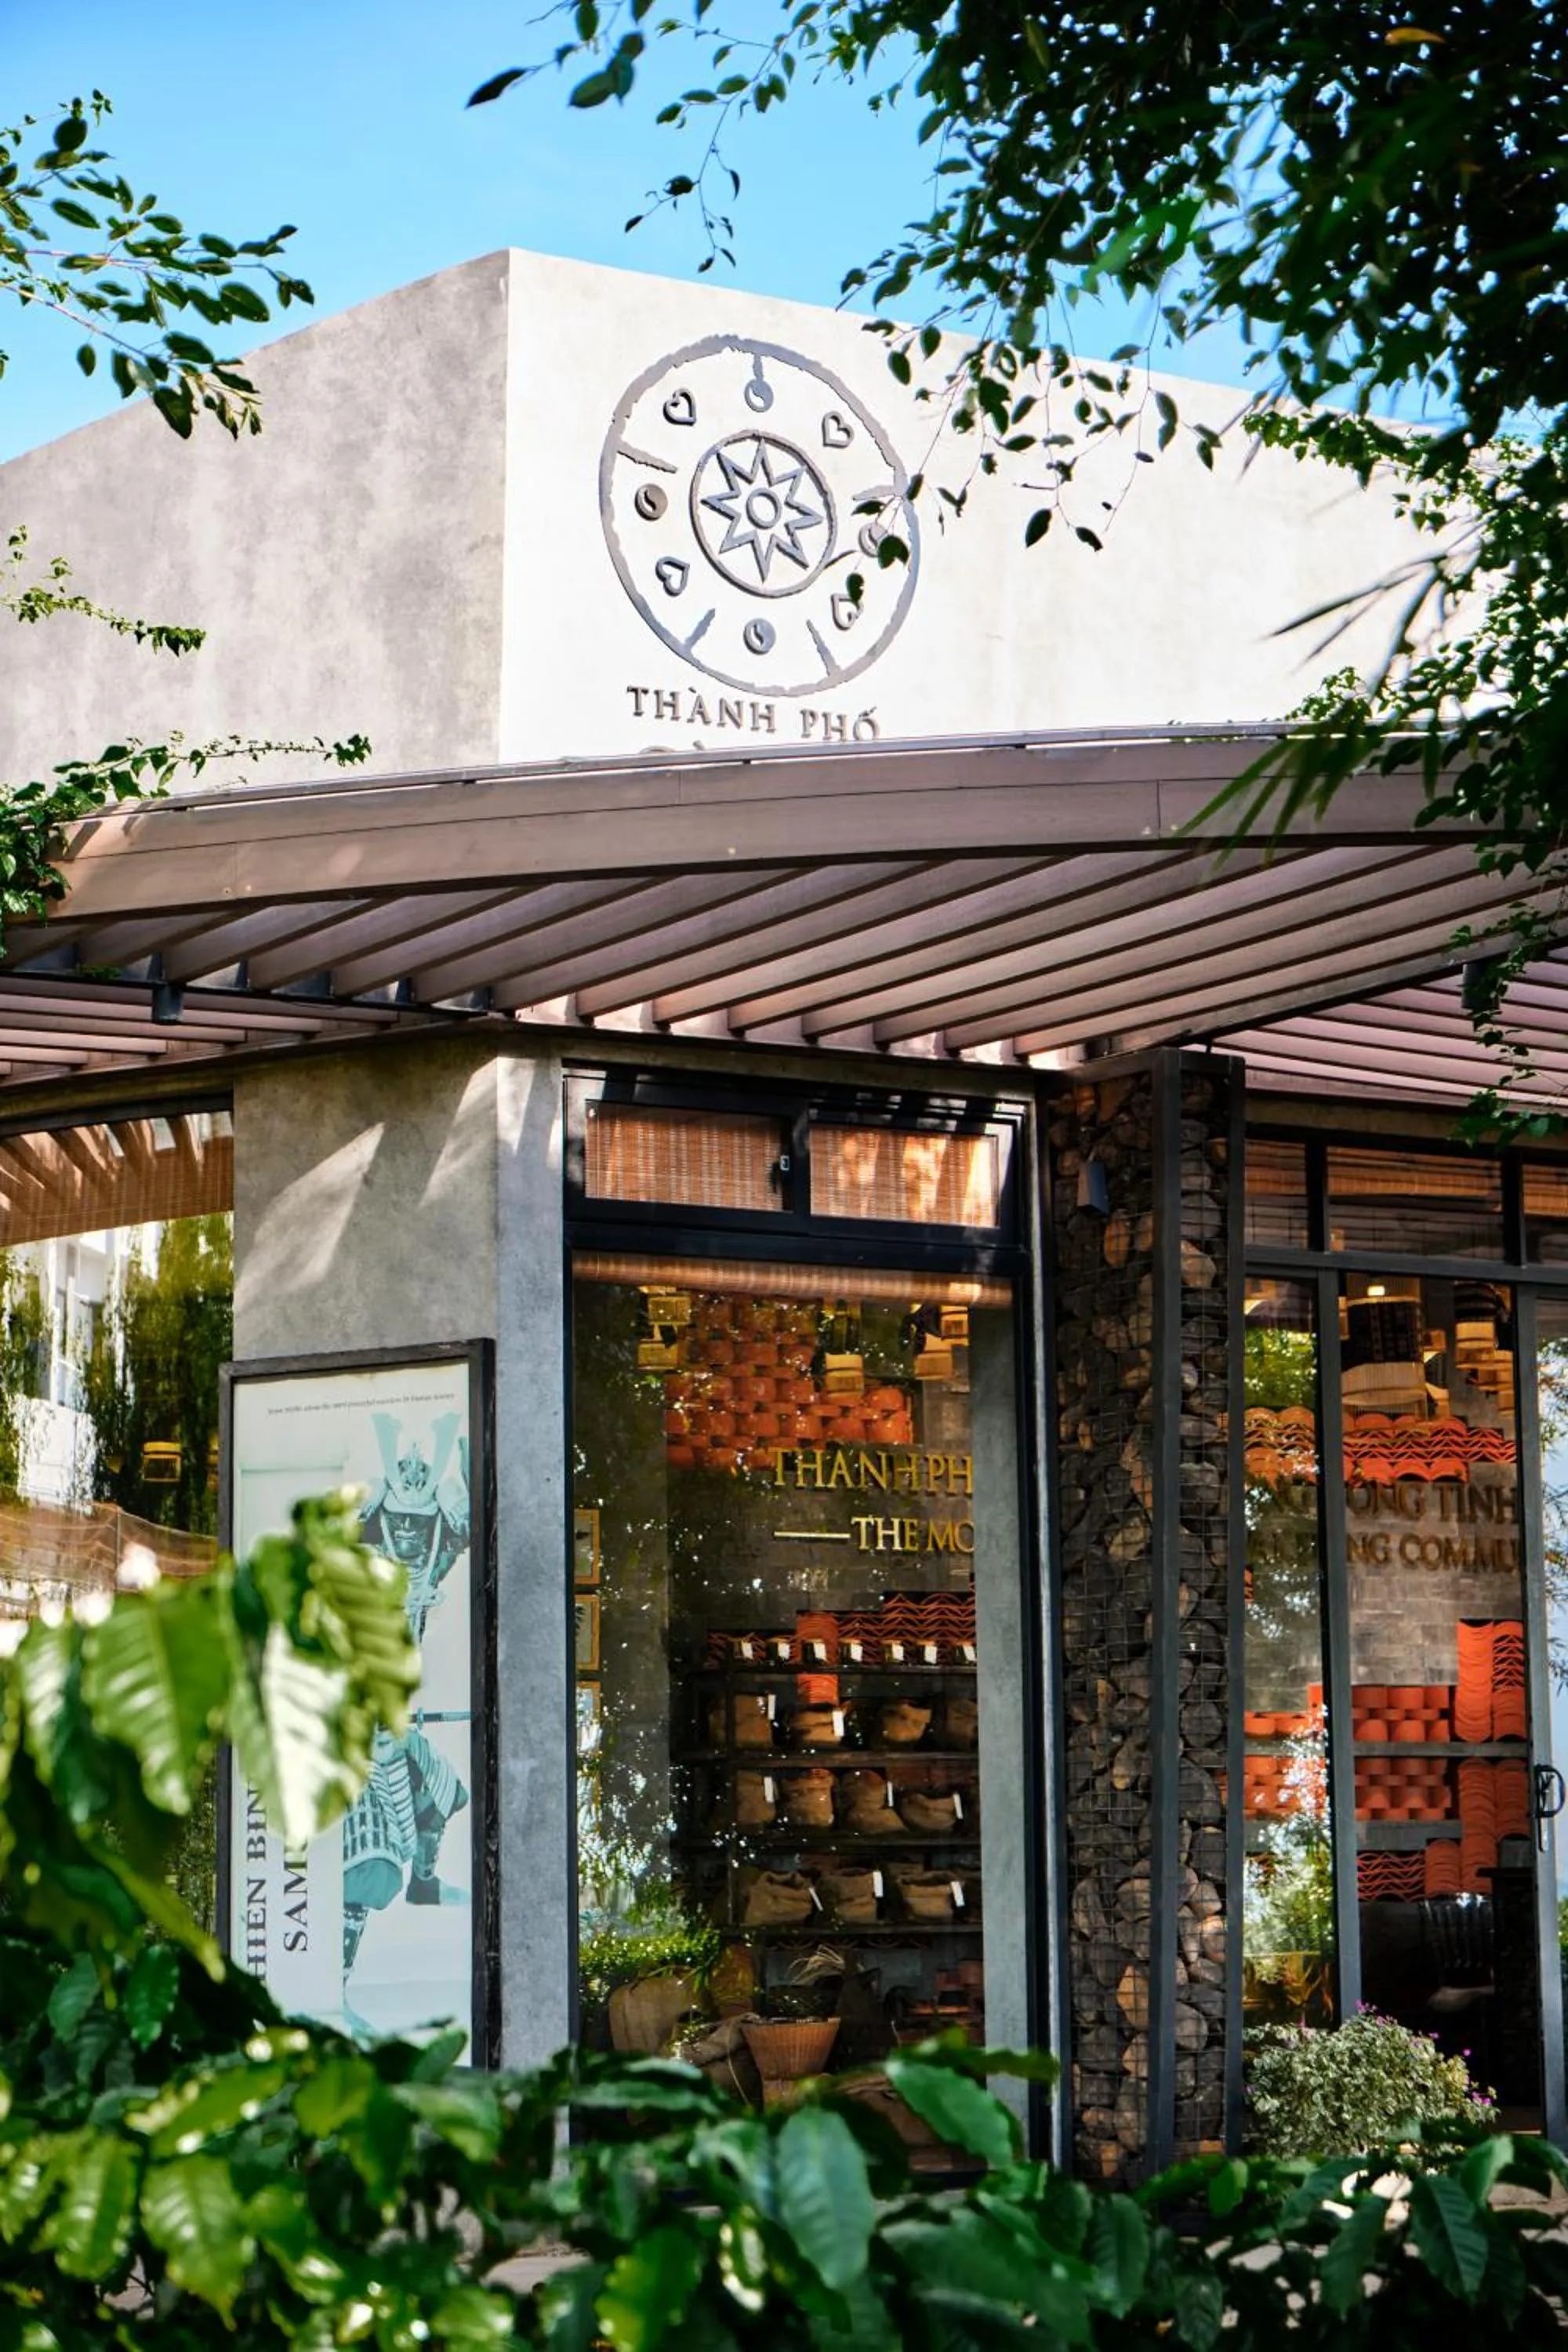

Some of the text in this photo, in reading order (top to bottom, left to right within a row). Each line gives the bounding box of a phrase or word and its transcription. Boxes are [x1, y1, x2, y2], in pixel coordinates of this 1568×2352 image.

[627, 686, 880, 742] THÀNH PHỐ
[851, 1517, 917, 1553] THE
